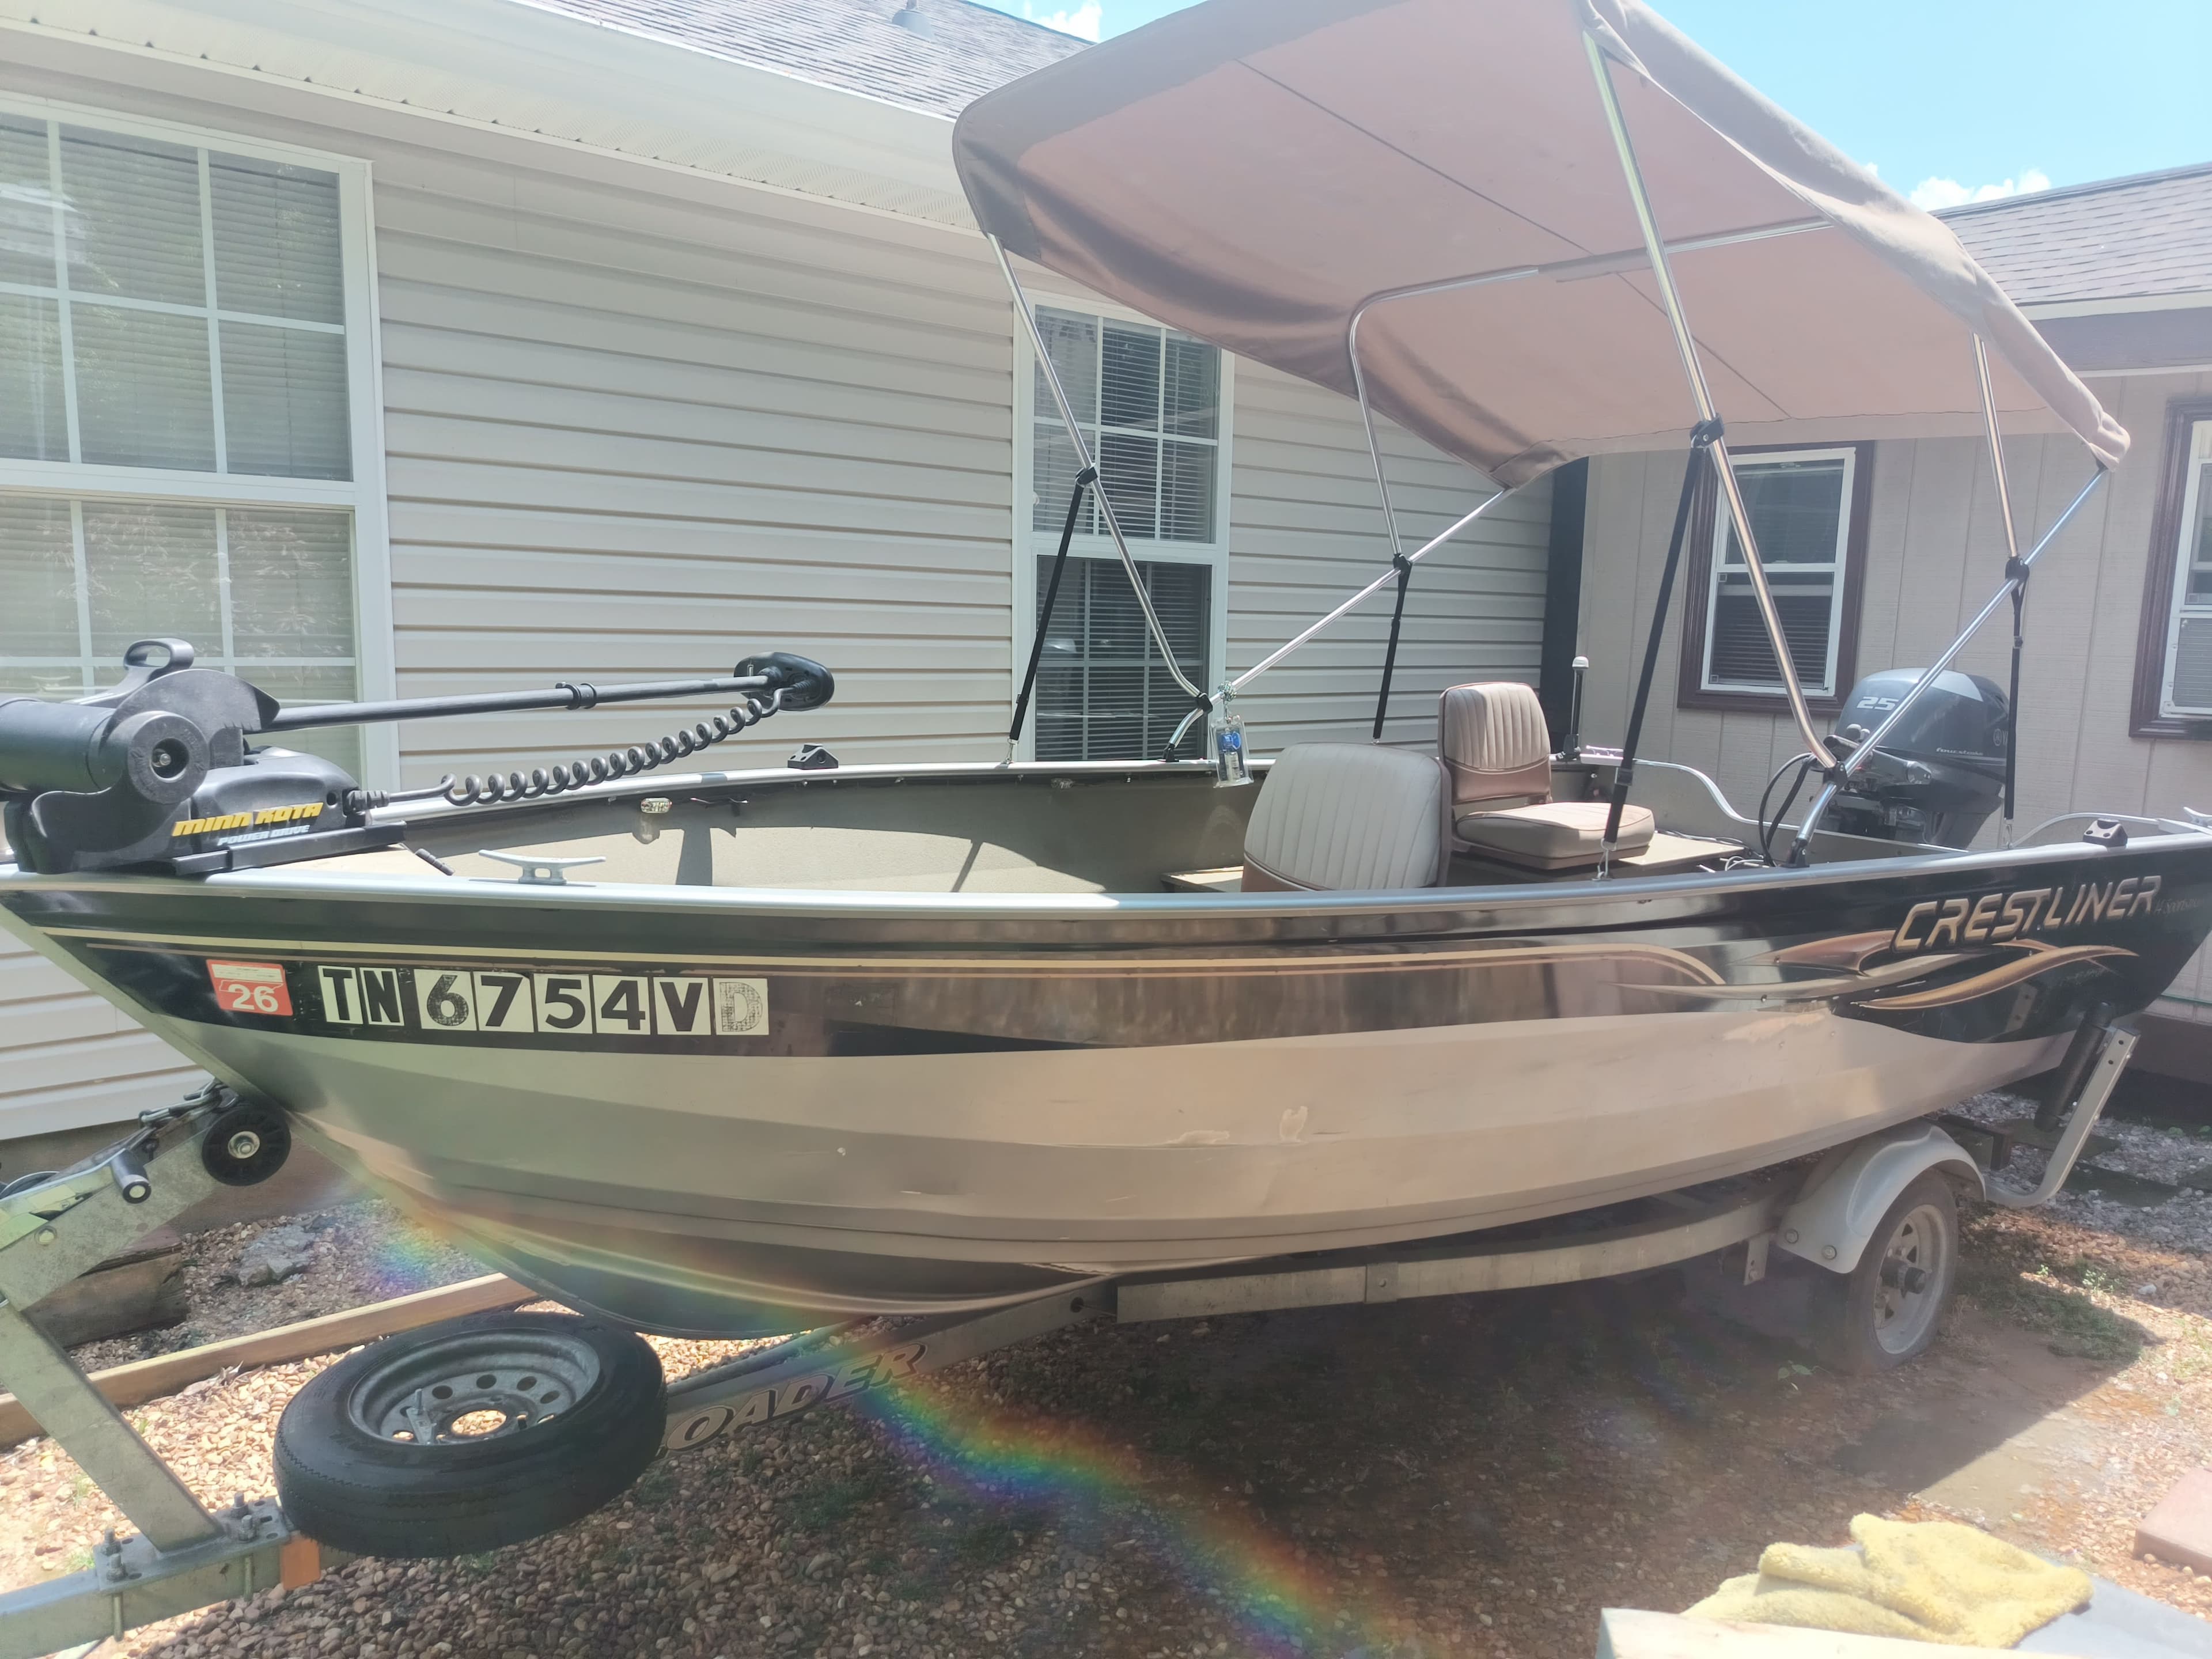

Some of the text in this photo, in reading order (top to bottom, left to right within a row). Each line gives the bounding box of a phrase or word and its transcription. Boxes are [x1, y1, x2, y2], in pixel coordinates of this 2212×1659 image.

[1857, 696, 1899, 711] 25
[255, 802, 324, 824] KOTA
[217, 825, 310, 846] POWER DRIVE
[1893, 875, 2162, 952] CRESTLINER
[228, 983, 279, 1013] 26
[322, 968, 402, 1024] TN
[656, 1343, 926, 1457] OADER
